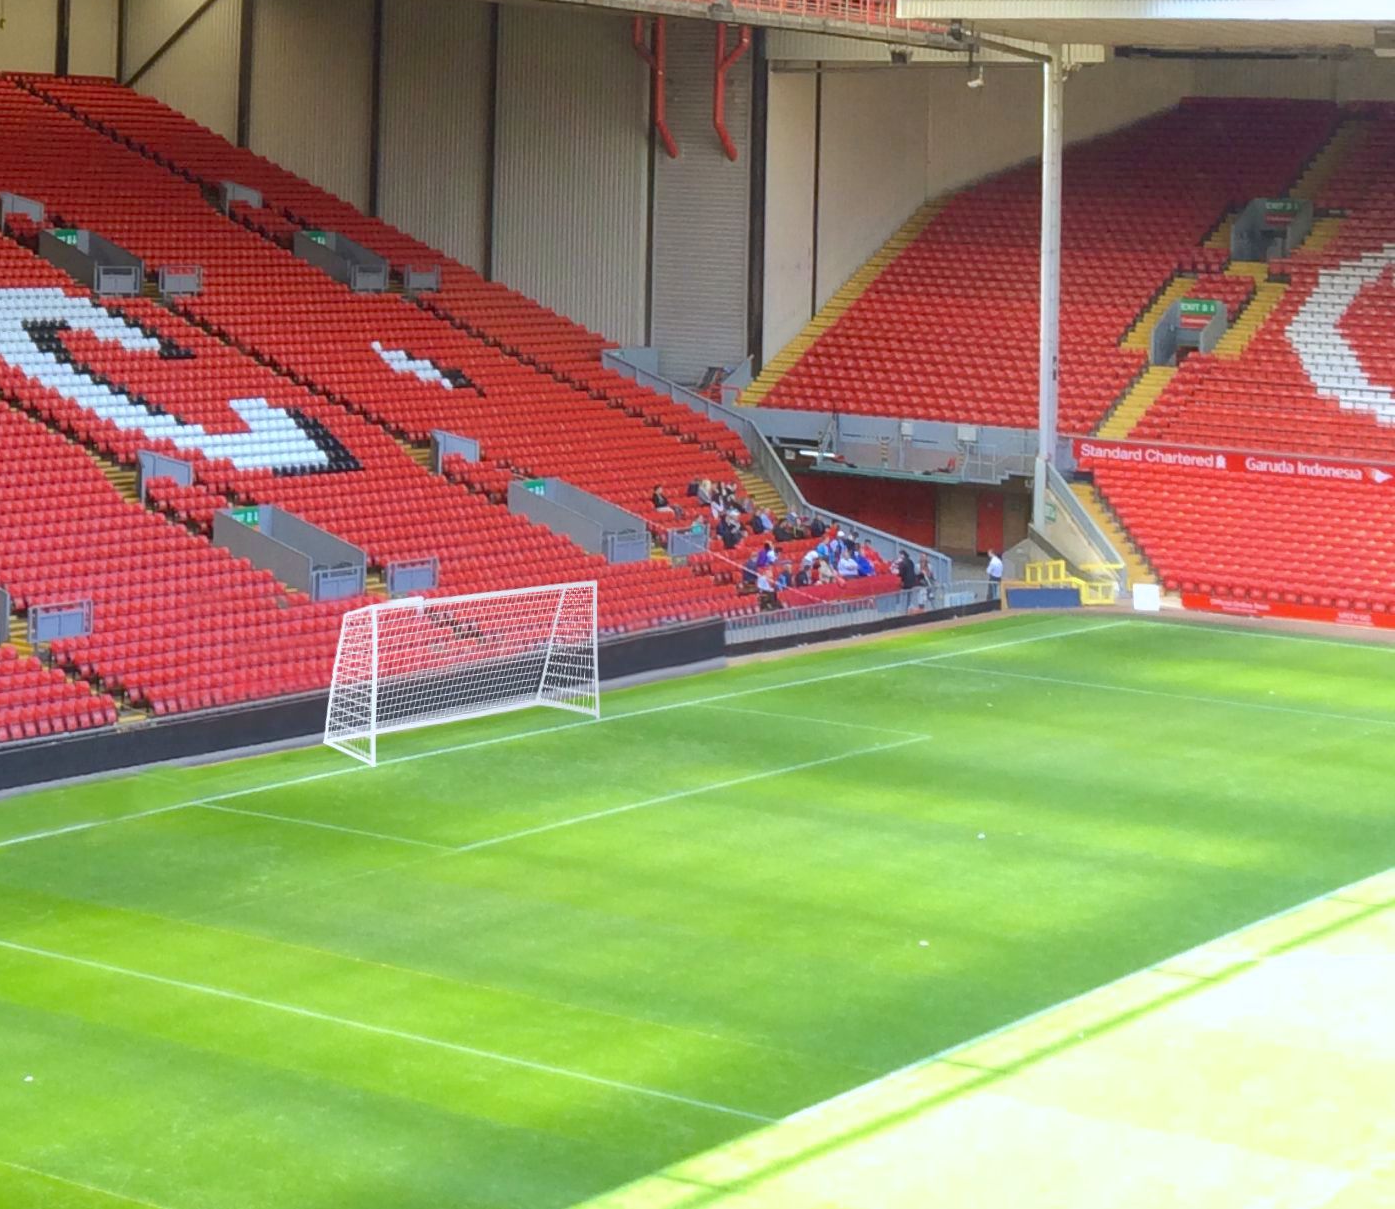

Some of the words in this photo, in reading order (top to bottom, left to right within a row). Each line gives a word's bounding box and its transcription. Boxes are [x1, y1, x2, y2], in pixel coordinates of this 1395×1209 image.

[1080, 443, 1143, 461] Standard
[1145, 448, 1215, 468] Chartered
[1245, 456, 1295, 474] Garuda
[1297, 460, 1363, 481] Indonesia
